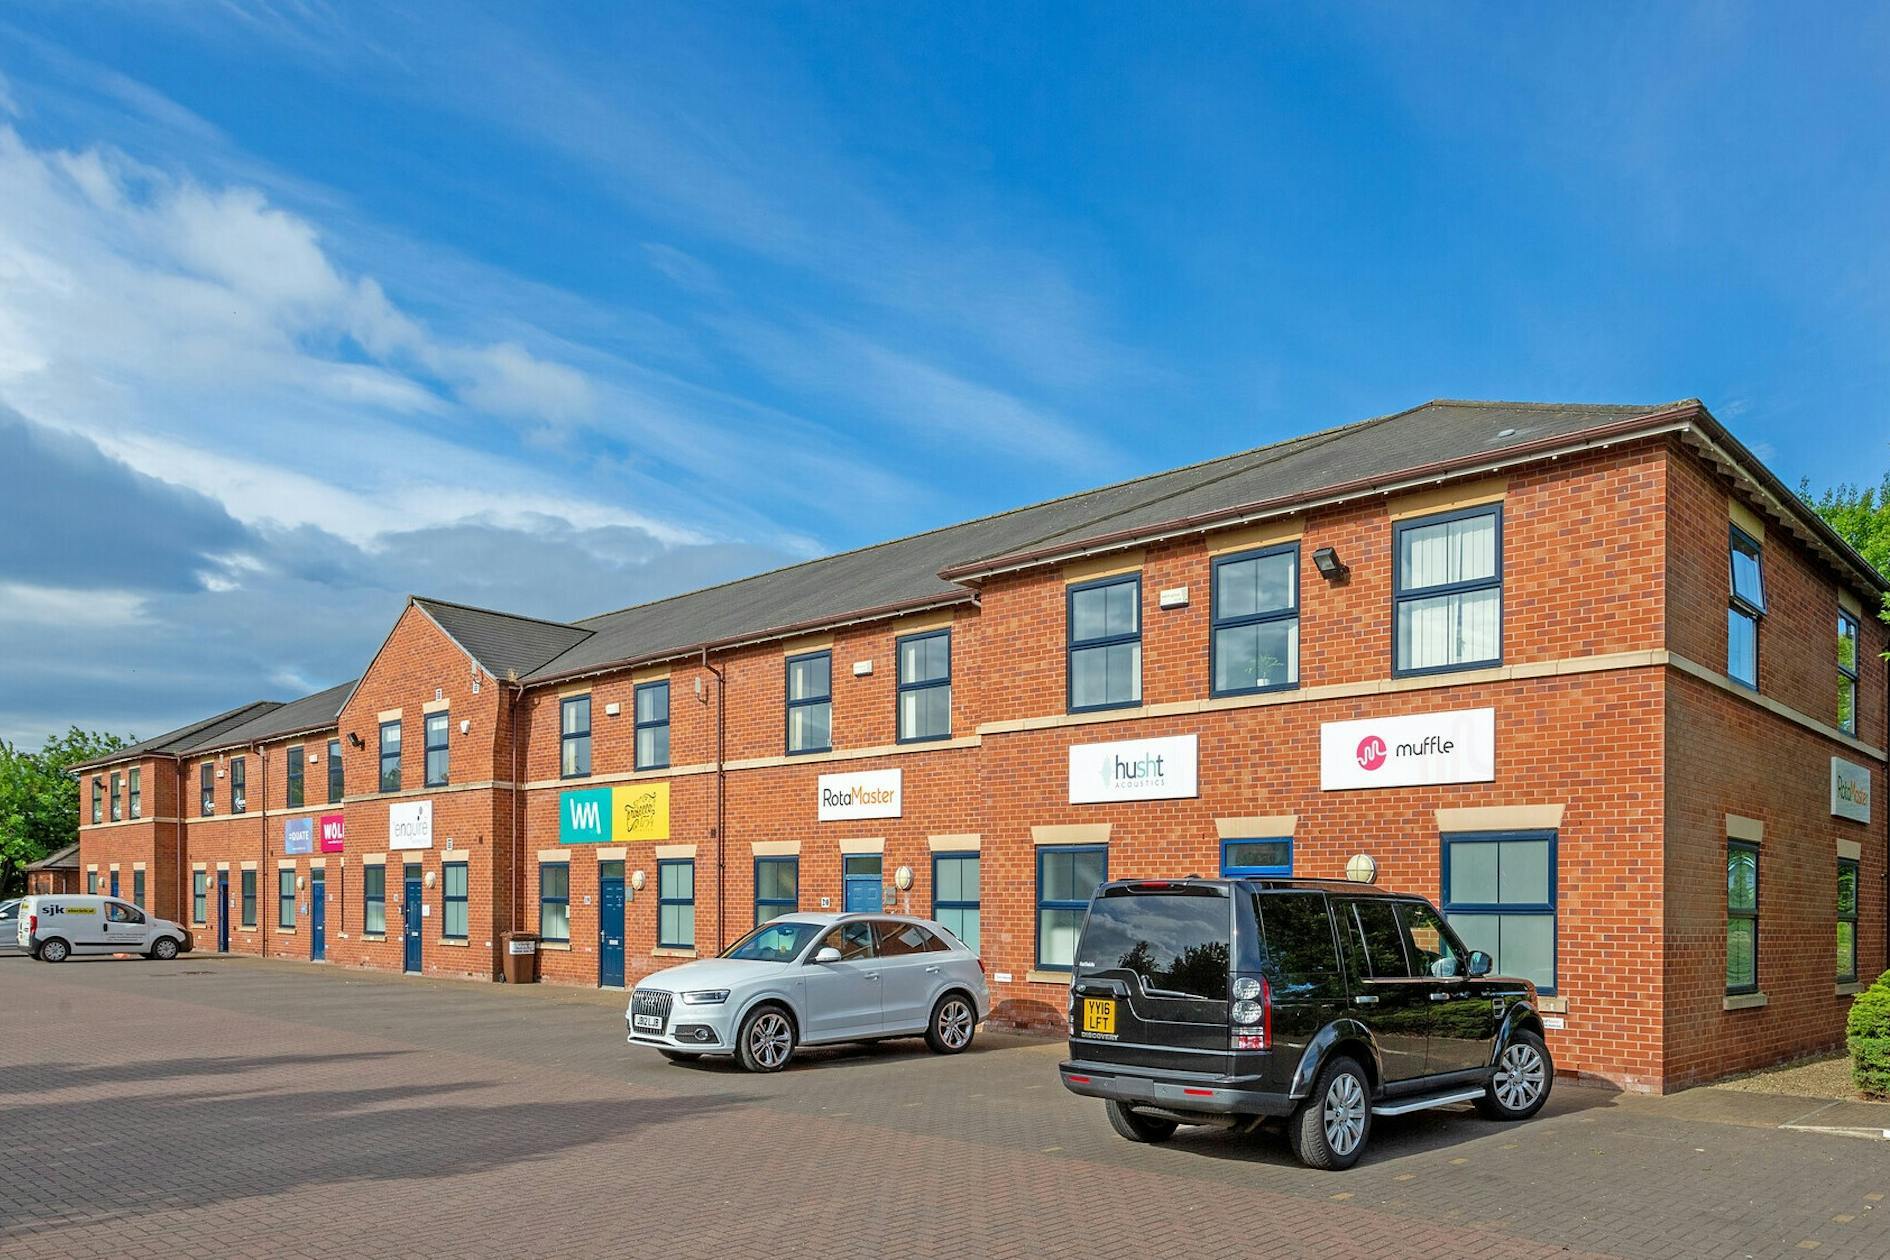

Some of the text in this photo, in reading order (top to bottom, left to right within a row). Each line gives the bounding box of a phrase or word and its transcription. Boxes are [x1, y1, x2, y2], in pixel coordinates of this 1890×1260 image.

[1396, 736, 1454, 757] muffle
[1115, 752, 1164, 779] husht
[1115, 779, 1165, 789] ACOUSTICS
[823, 785, 895, 807] RotaMaster
[323, 822, 345, 840] WOL
[42, 905, 65, 916] sjk
[1088, 1001, 1110, 1015] YY16
[1089, 1016, 1109, 1030] LFT
[1081, 1031, 1119, 1041] DISCOVERY
